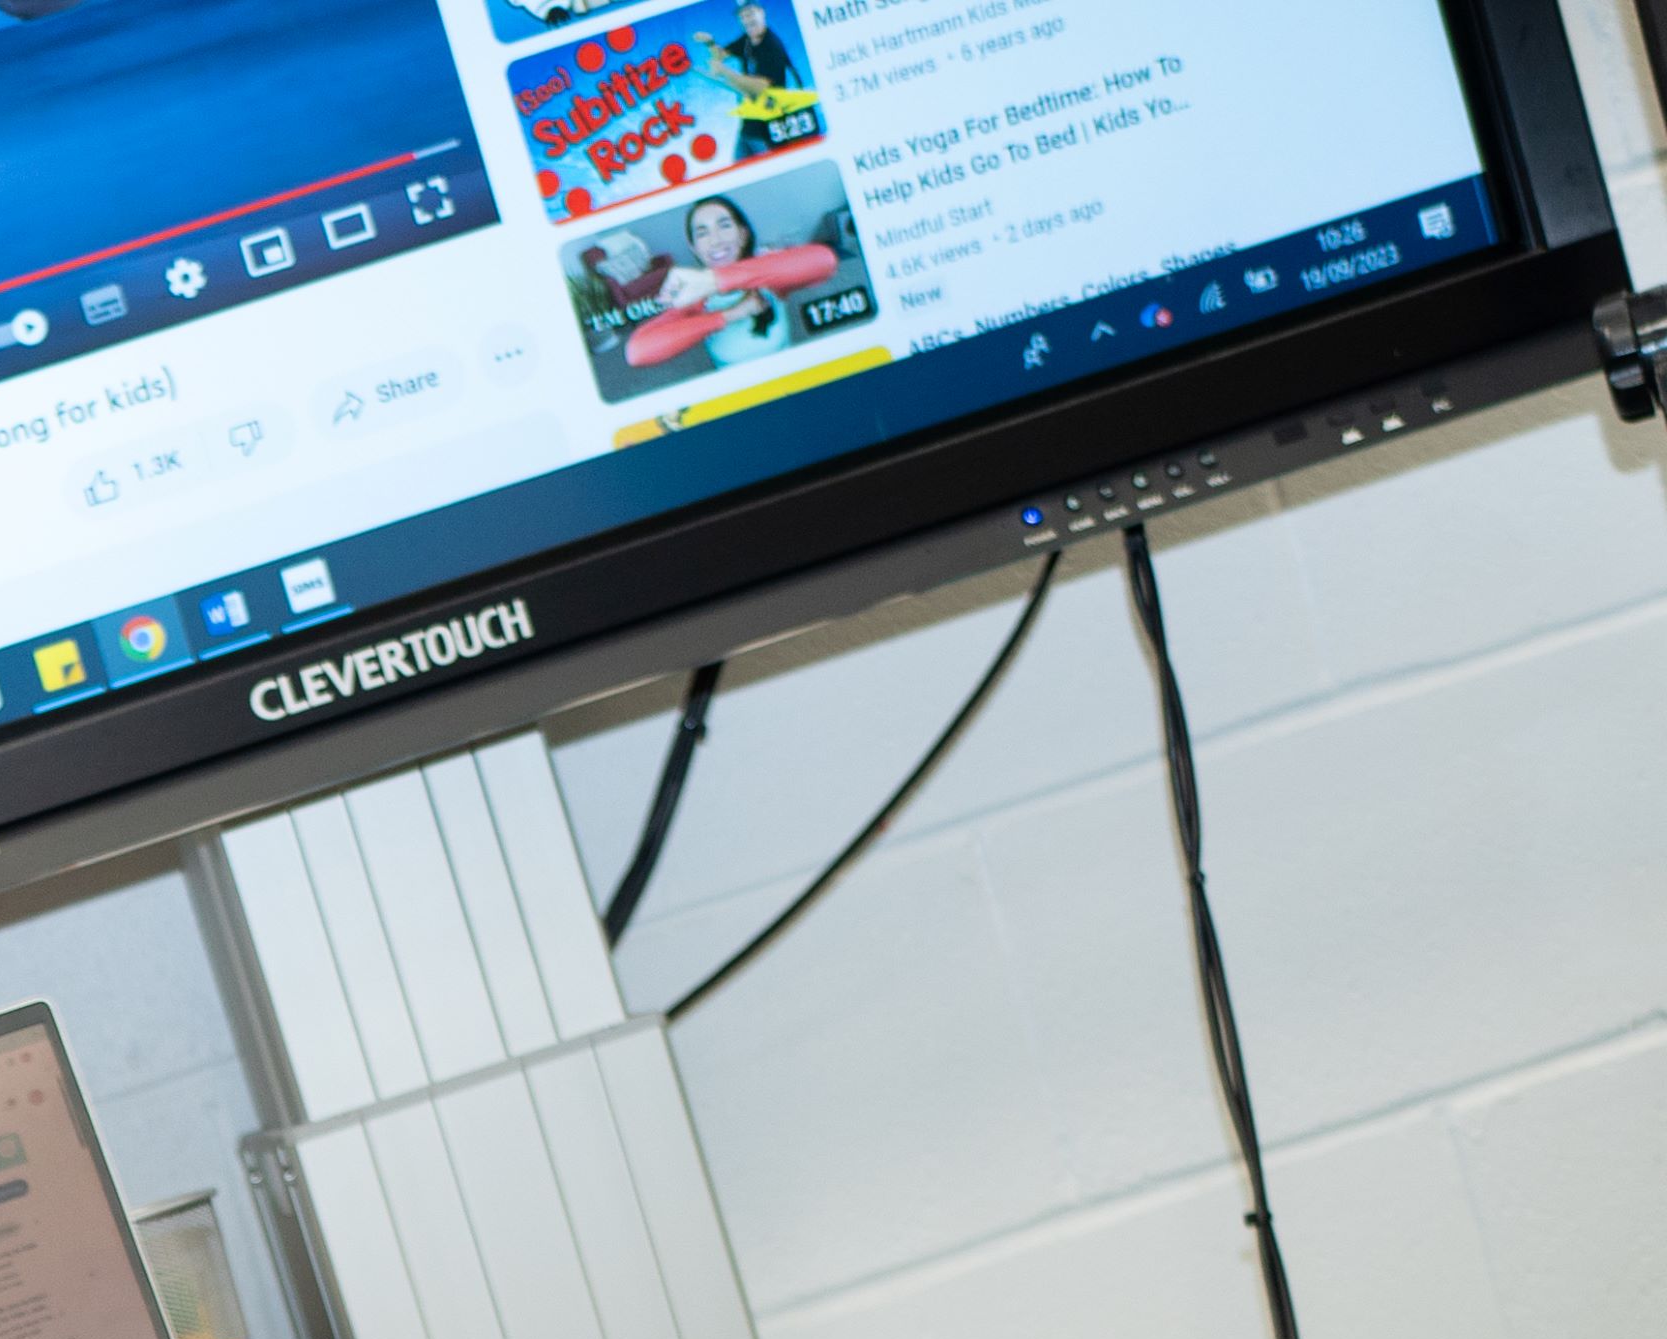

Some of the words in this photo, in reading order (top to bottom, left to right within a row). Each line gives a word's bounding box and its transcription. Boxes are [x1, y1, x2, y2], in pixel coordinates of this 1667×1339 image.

[823, 39, 870, 71] Jack
[870, 8, 964, 55] Hartmann
[880, 53, 938, 87] views
[974, 27, 1028, 61] years
[1027, 15, 1068, 45] ago
[533, 43, 693, 158] Subitize
[852, 140, 905, 175] Kids
[905, 124, 963, 161] Yoga
[962, 111, 1002, 140] For
[1002, 79, 1100, 128] Bedtime:
[1102, 62, 1154, 95] How
[1153, 53, 1184, 79] To
[586, 97, 696, 184] Rock
[862, 176, 916, 213] Help
[916, 159, 966, 193] Kids
[969, 149, 1003, 176] Go
[1004, 139, 1033, 165] To
[1034, 124, 1079, 155] Bed
[1091, 103, 1142, 137] Kids
[874, 212, 945, 251] Mindful
[944, 197, 994, 229] Start
[927, 235, 983, 268] views
[1003, 223, 1020, 244] 2
[1019, 208, 1068, 243] days
[1066, 198, 1107, 228] ago
[897, 283, 943, 313] New
[53, 393, 100, 431] for
[103, 366, 179, 417] kids)
[375, 366, 440, 405] Share
[130, 449, 184, 484] 1.3K
[249, 600, 535, 721] CLEVERTOUCH
